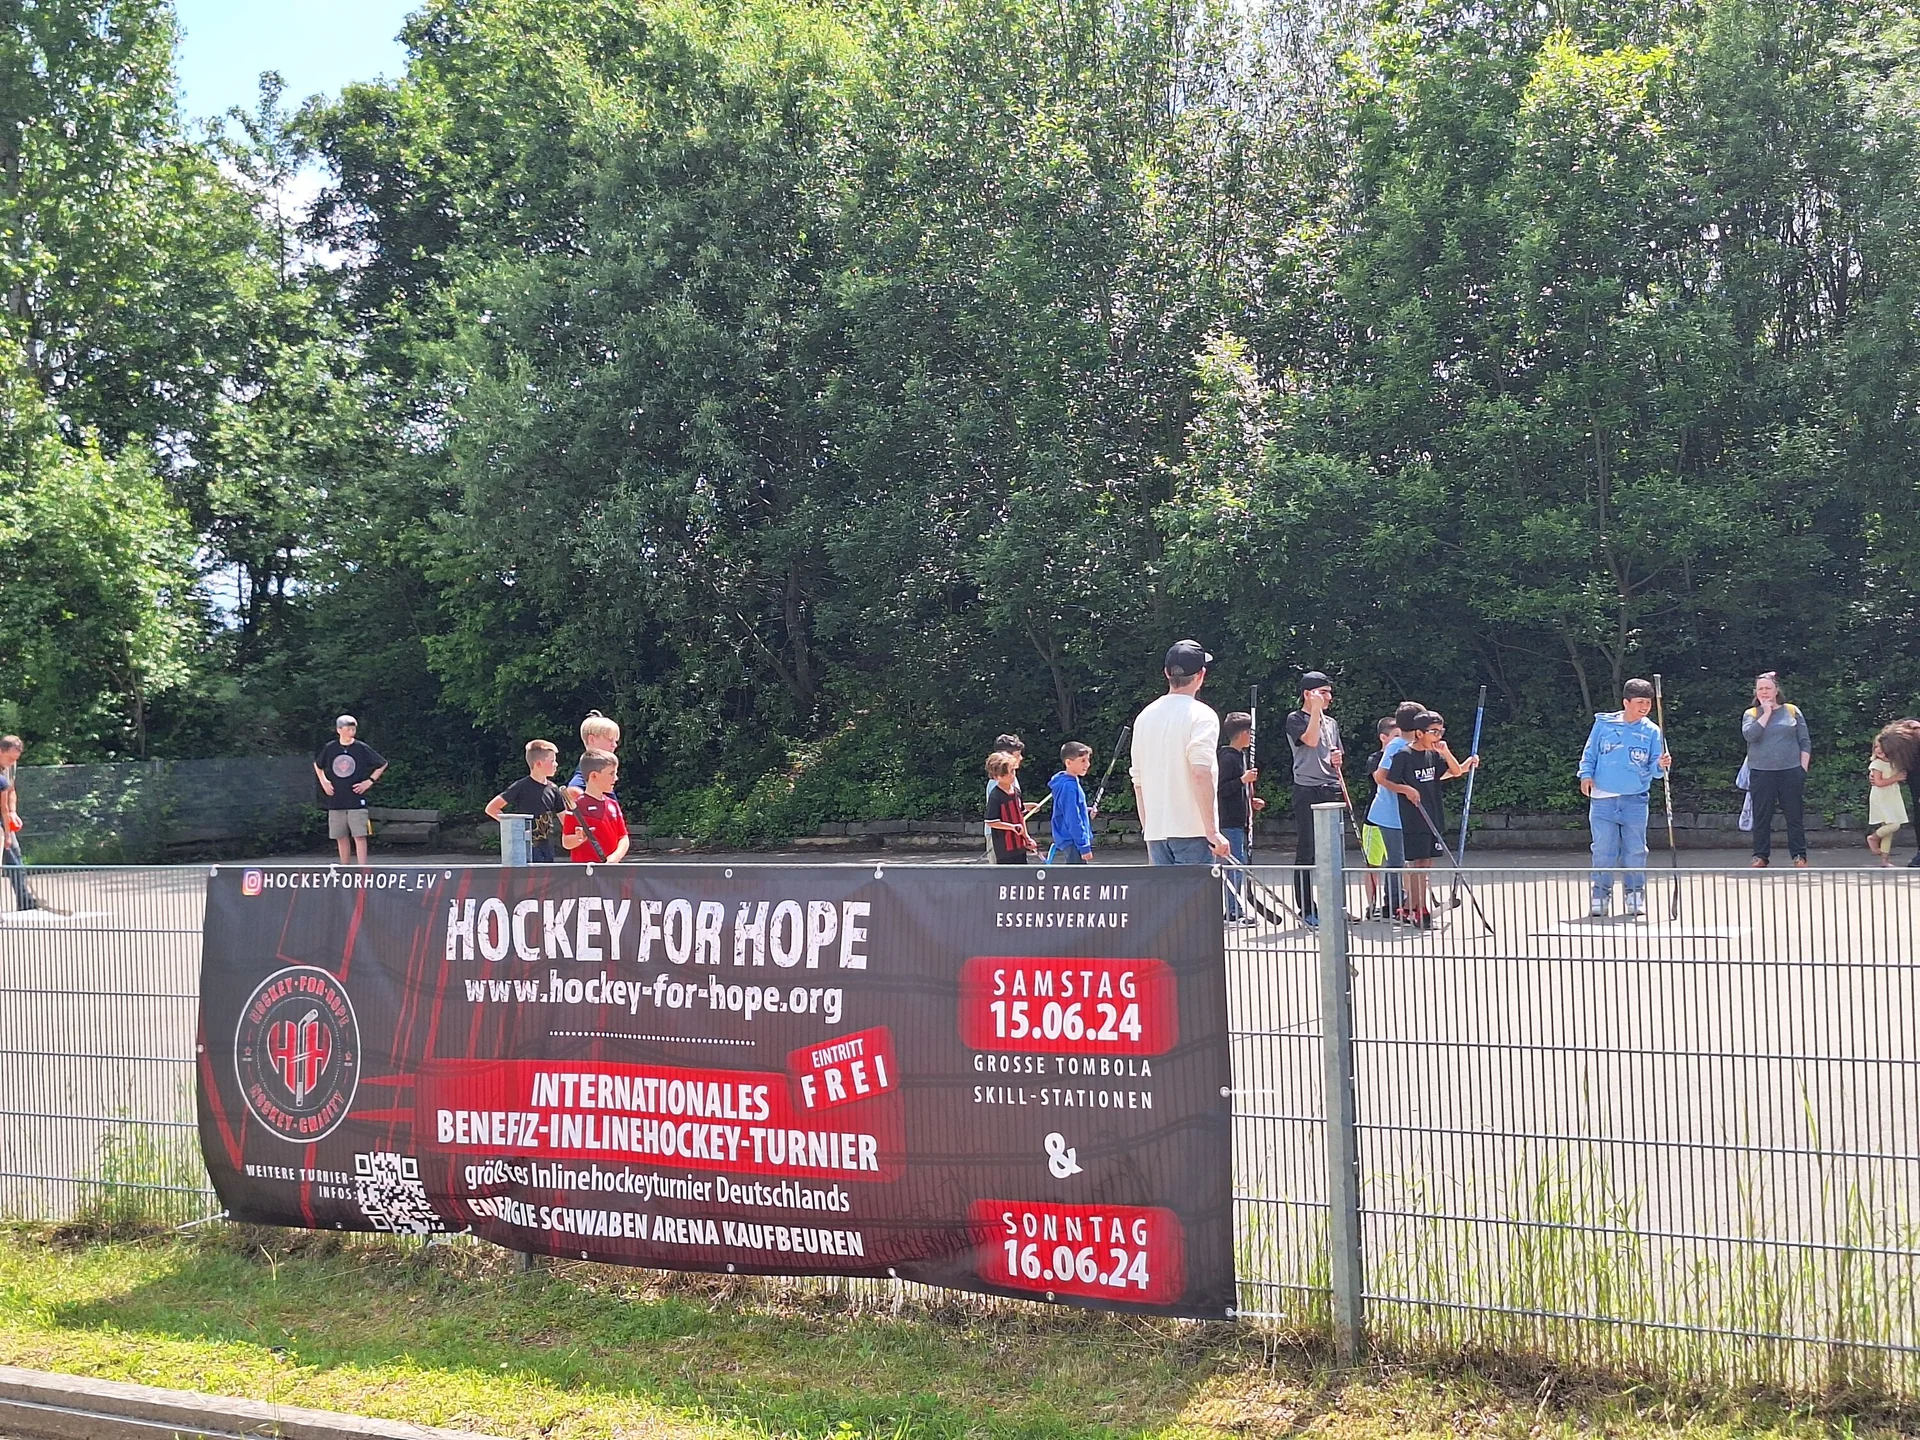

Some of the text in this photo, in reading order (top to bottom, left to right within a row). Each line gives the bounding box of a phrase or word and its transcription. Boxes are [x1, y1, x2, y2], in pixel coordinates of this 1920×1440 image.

[263, 872, 437, 892] HOCKEYFORHOPE_EV
[999, 885, 1129, 901] BEIDE TAGE MIT
[445, 896, 872, 971] HOCKEY FOR HOPE
[996, 912, 1130, 929] ESSENSVERKAUF
[464, 969, 844, 1025] www.hockey-for-hope.org
[993, 969, 1137, 999] SAMSTAG
[989, 1000, 1143, 1042] 15.06.24
[811, 1037, 866, 1069] EINTRITT
[973, 1054, 1153, 1078] GROSSE TOMBOLA
[530, 1071, 770, 1121] INTERNATIONALES
[799, 1055, 889, 1109] FREI
[973, 1086, 1153, 1110] SKILL-STATIONEN
[436, 1109, 880, 1172] BENEFIZ-INLINEHOCKEY-TURNIER
[1043, 1131, 1084, 1179] &
[246, 1164, 295, 1181] WEITERE
[464, 1159, 851, 1213] größtes Inlinehockeyturnier Deutschlands
[318, 1184, 358, 1201] INFOS:
[466, 1196, 866, 1257] ENERGIE SCHWABEN ARENA KAUFBEUREN
[1002, 1212, 1148, 1246] SONNTAG
[1003, 1239, 1150, 1290] 16.06.24
